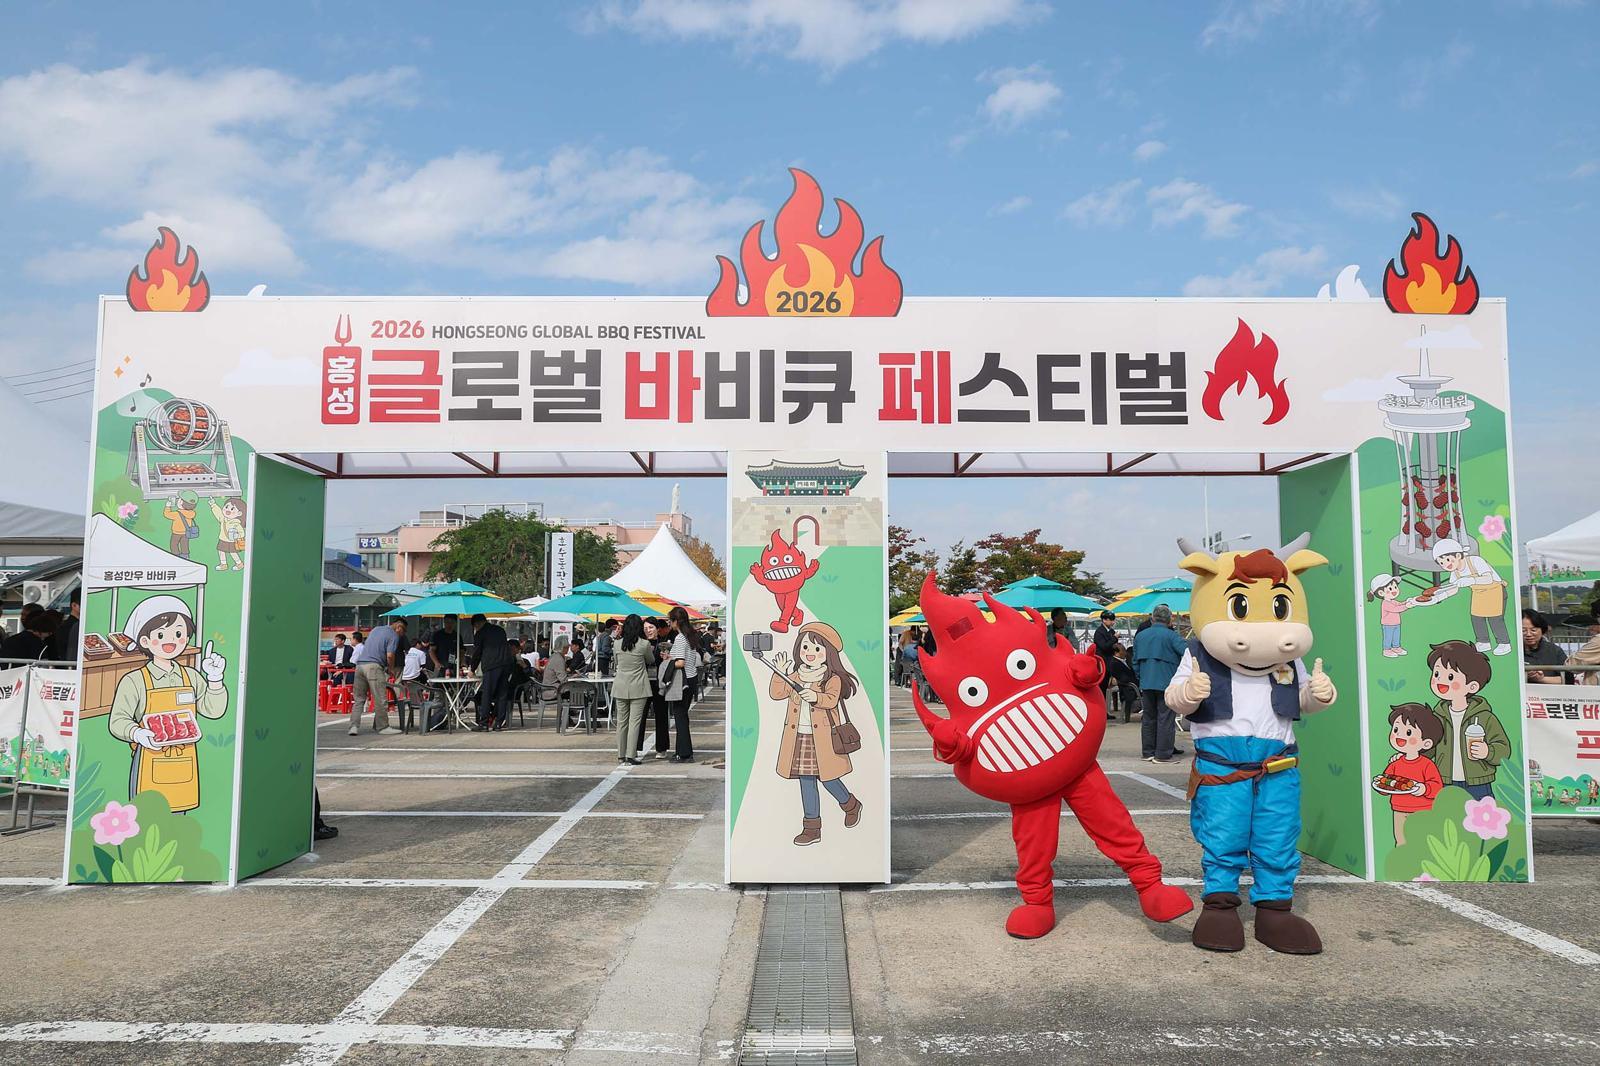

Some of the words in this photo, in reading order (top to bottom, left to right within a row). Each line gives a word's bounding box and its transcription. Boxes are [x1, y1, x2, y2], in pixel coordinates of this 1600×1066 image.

[777, 291, 841, 313] 2026
[370, 320, 425, 339] 2026
[432, 325, 528, 339] HONGSEONG
[532, 325, 593, 339] GLOBAL
[597, 325, 630, 341] BBQ
[634, 326, 706, 340] FESTIVAL
[327, 355, 354, 416] 홍성
[367, 349, 602, 423] 글로벌
[624, 349, 856, 425] 바비큐
[877, 350, 1189, 425] 페스티벌
[103, 570, 144, 581] 홍성한우
[146, 570, 177, 581] 바비큐
[1530, 703, 1580, 720] 글로벌
